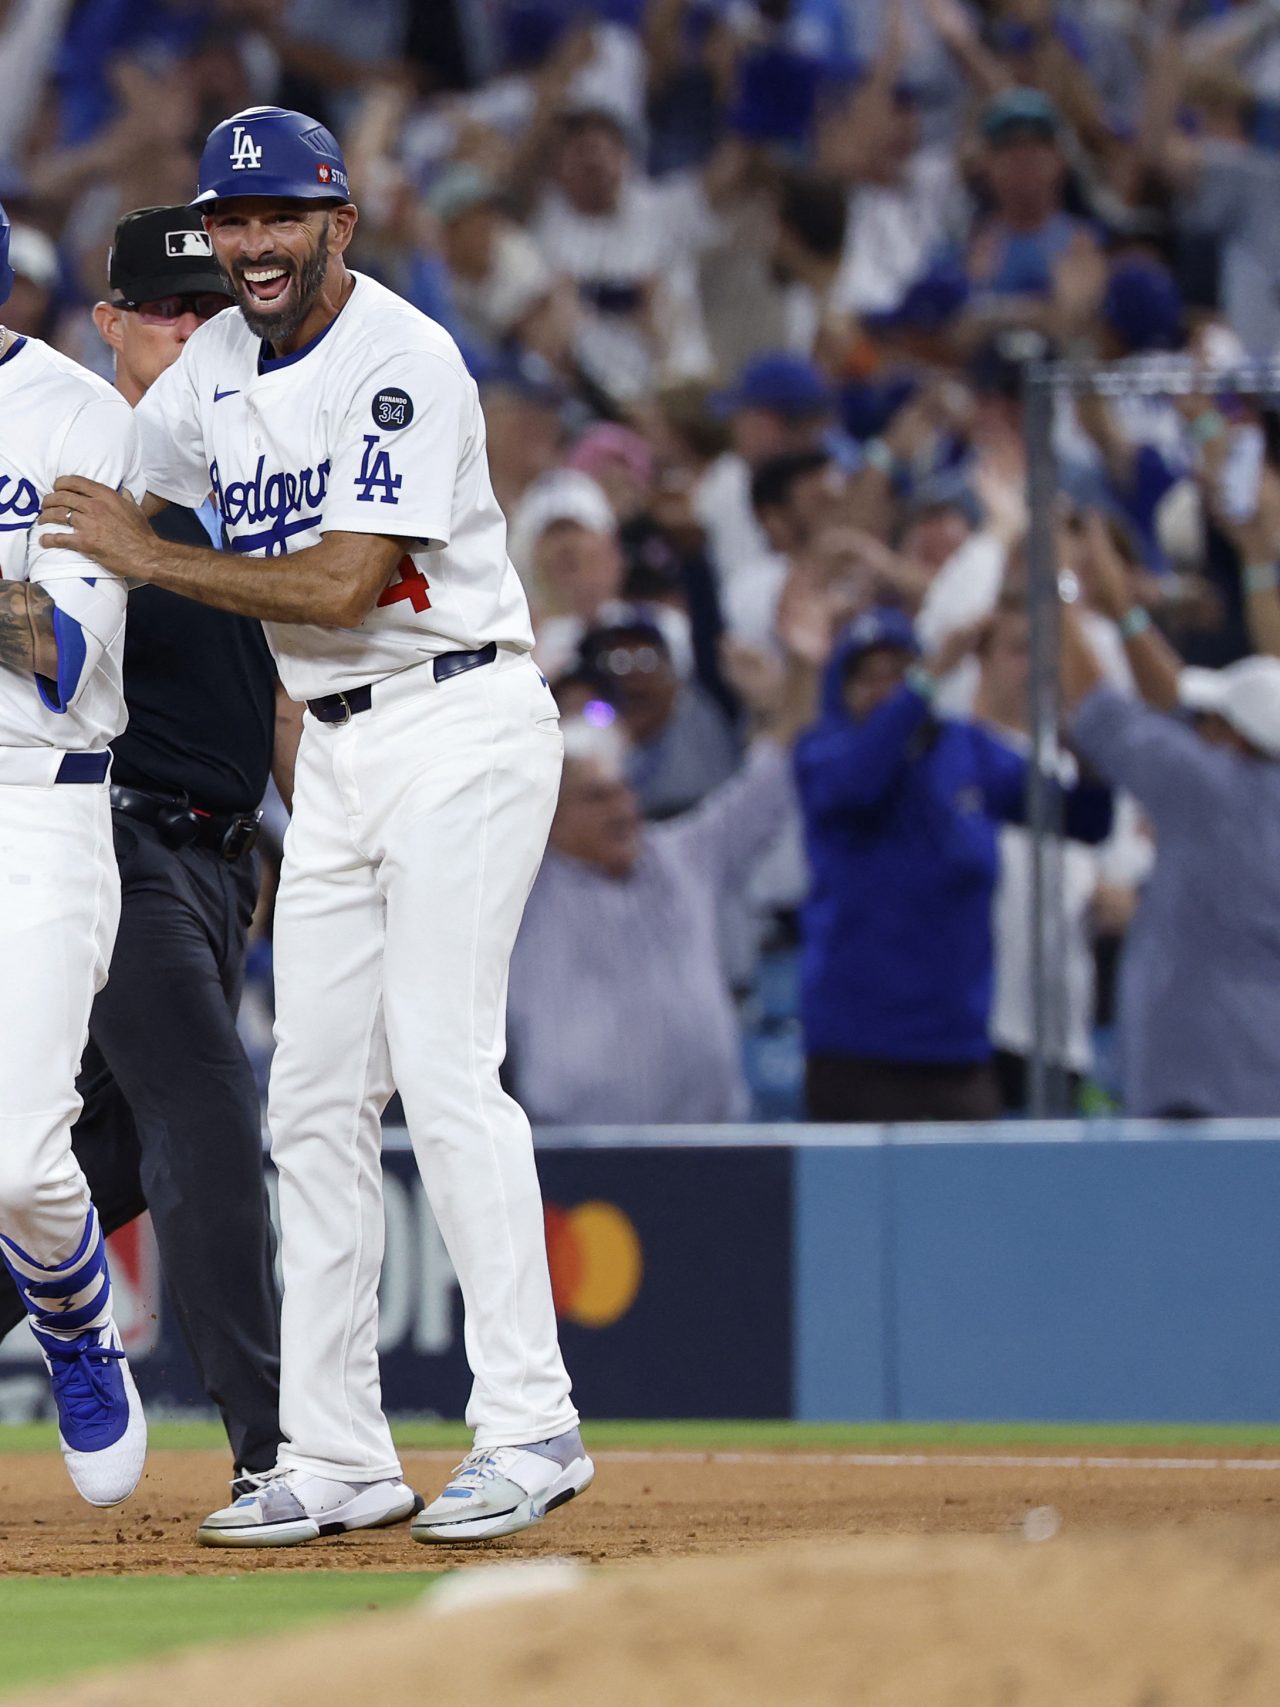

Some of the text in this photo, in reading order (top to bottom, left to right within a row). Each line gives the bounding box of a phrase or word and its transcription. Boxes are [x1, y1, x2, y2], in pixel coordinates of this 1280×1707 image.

[229, 126, 263, 170] LA
[378, 402, 405, 425] 34
[379, 395, 408, 405] FERNANDO
[353, 434, 403, 505] LA
